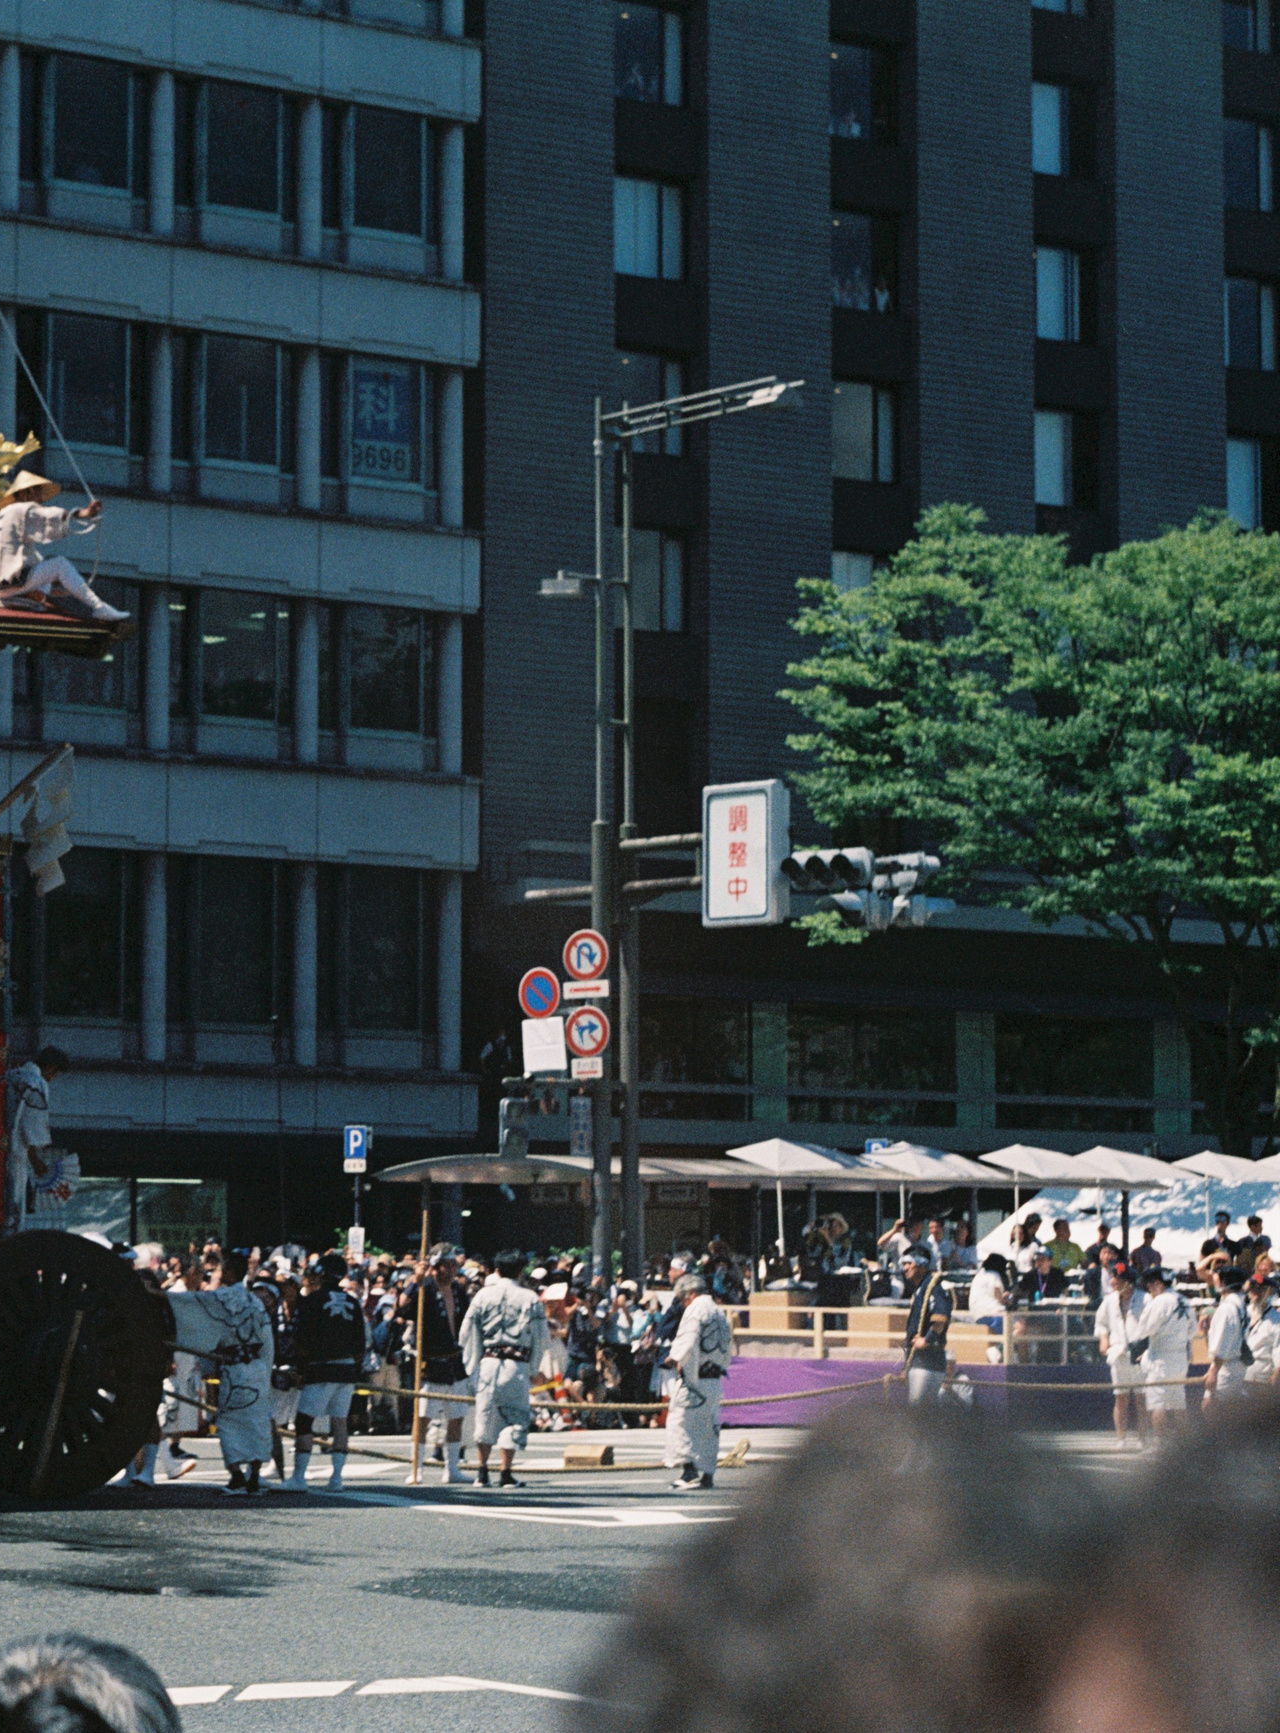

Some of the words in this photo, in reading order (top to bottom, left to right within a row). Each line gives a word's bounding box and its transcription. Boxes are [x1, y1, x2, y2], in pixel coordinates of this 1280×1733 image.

[357, 381, 400, 434] 科
[727, 804, 749, 902] 調整中
[349, 1129, 363, 1157] P
